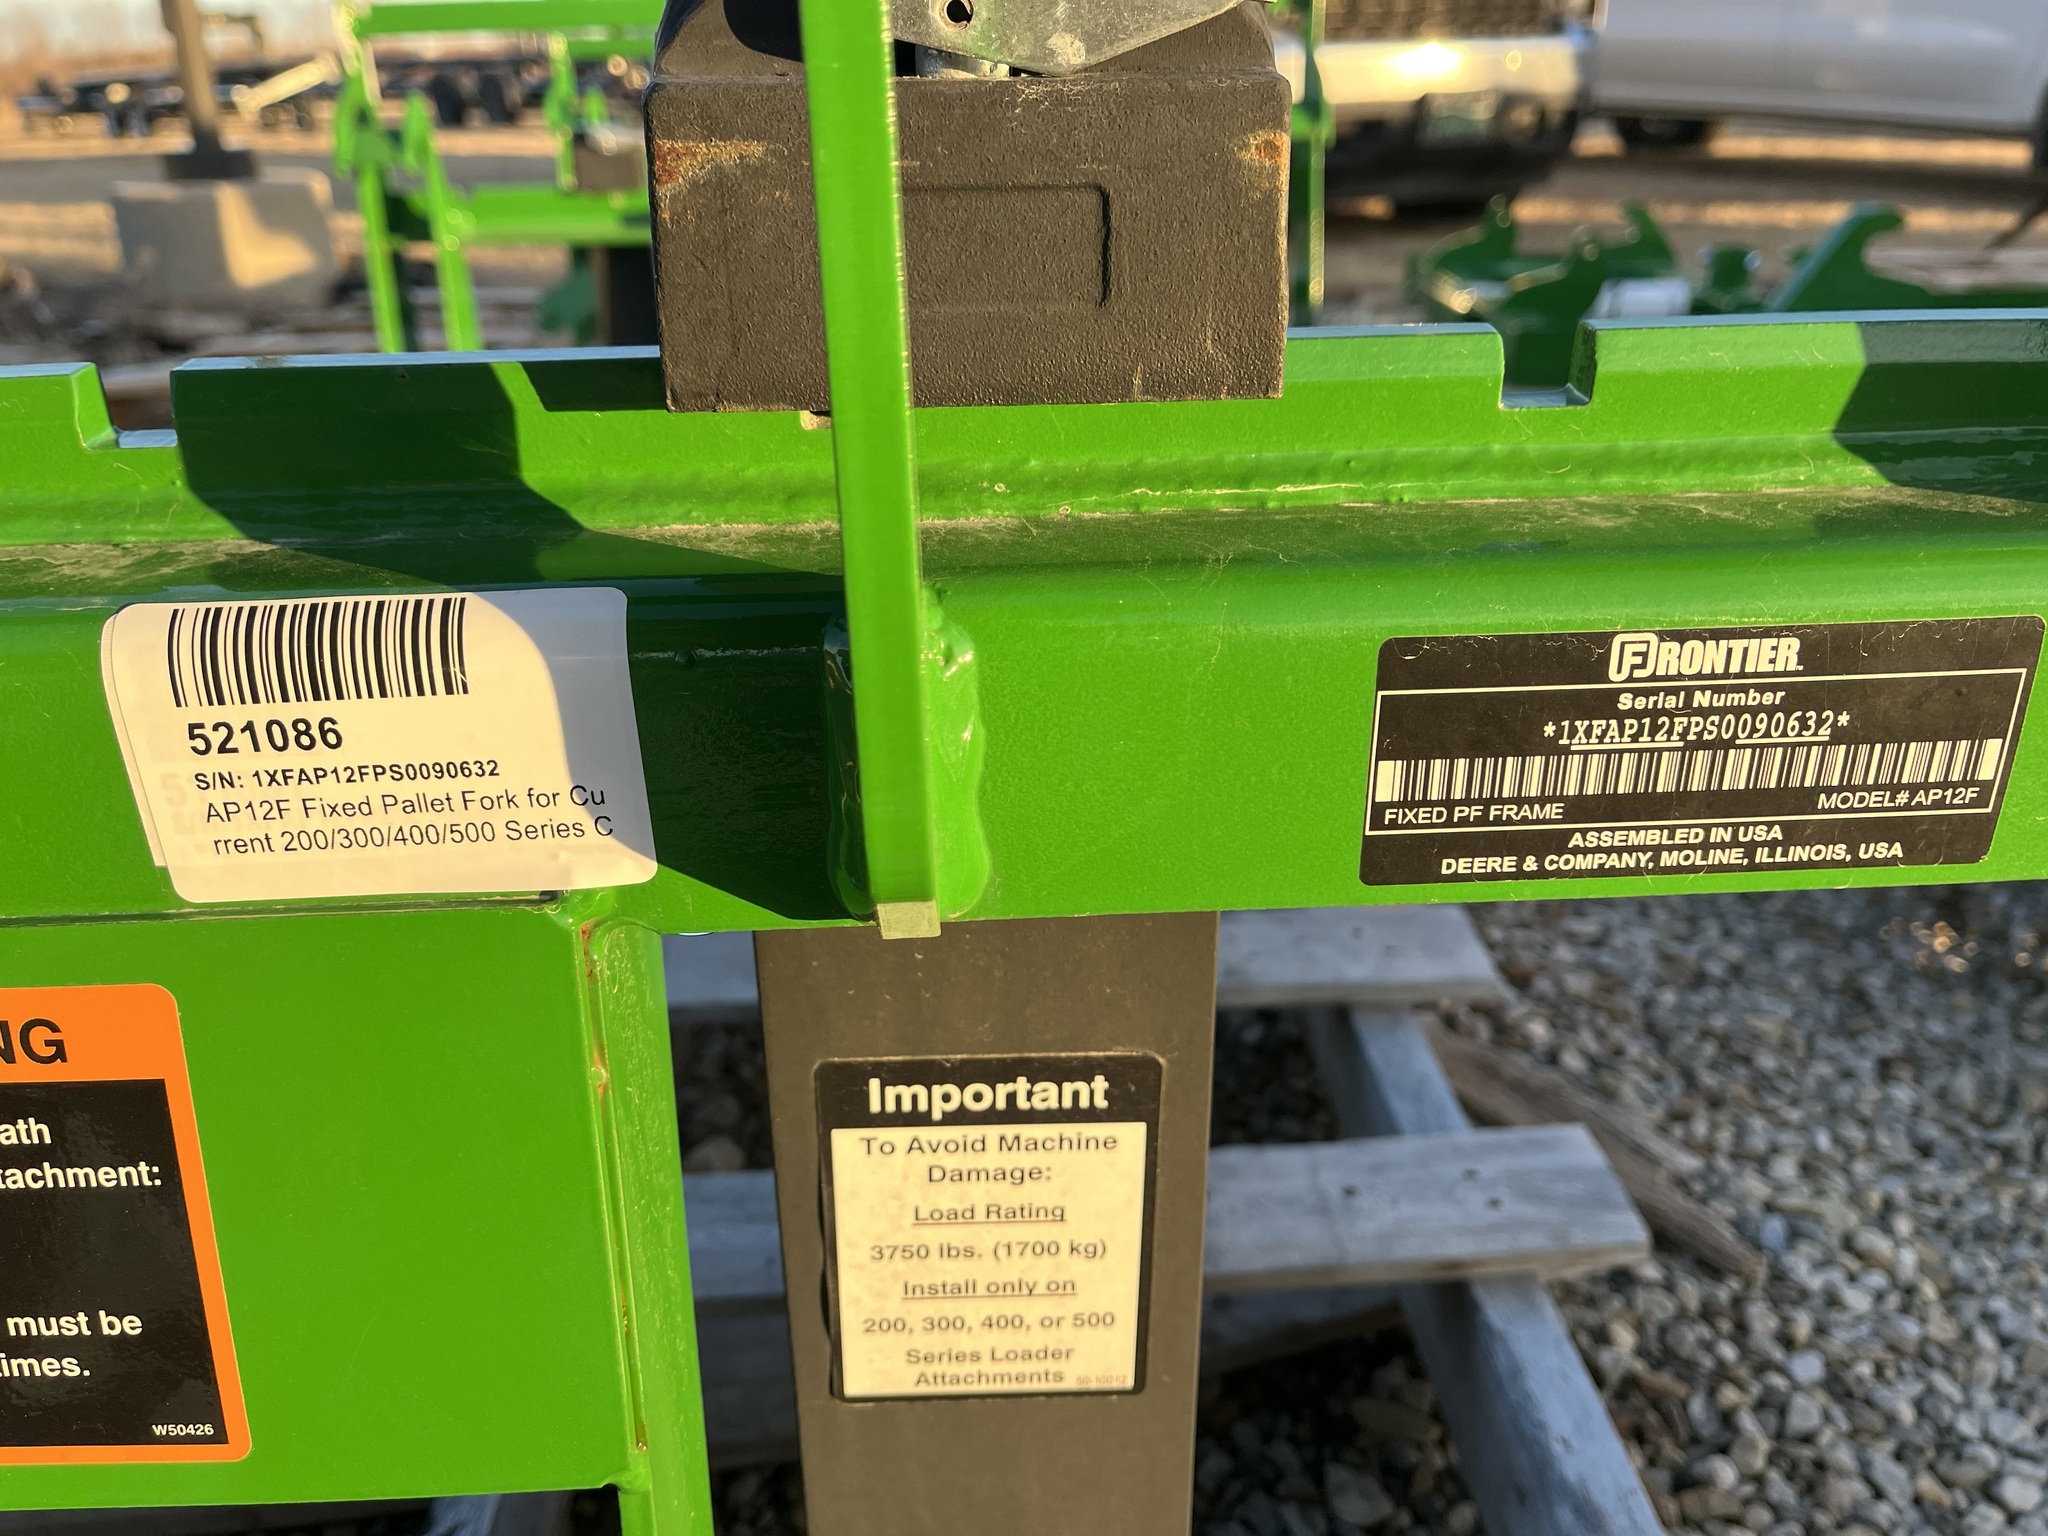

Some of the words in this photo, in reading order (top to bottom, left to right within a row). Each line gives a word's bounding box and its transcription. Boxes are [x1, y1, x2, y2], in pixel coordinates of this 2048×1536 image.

[1616, 691, 1686, 711] Serial
[1692, 688, 1786, 708] Number
[187, 716, 343, 756] 521086
[194, 770, 245, 791] S/N:
[252, 759, 500, 787] 1XFAP12FPS0090632
[206, 799, 291, 823] AP12F
[302, 795, 373, 819] Fixed
[381, 793, 455, 815] Pallet
[461, 788, 520, 812] Fork
[526, 786, 560, 809] for
[569, 784, 606, 807] Cu
[1817, 790, 1909, 810] MODEL#
[1911, 787, 1980, 806] AP12F
[1384, 806, 1448, 825] FIXED
[1453, 805, 1484, 823] PF
[1488, 802, 1565, 822] FRAME
[213, 832, 275, 856] rrent
[280, 821, 495, 852] 200/300/400/500
[505, 818, 586, 841] Series
[593, 816, 615, 838] C
[1567, 828, 1704, 849] ASSEMBLED
[1709, 827, 1732, 844] IN
[1737, 824, 1784, 843] USA
[1440, 855, 1517, 875] DEERE
[1522, 855, 1538, 872] &
[1543, 851, 1655, 874] COMPANY,
[1659, 848, 1749, 870] MOLINE,
[1754, 844, 1852, 864] ILLINOIS,
[1857, 841, 1904, 860] USA
[868, 1074, 1109, 1121] Important
[860, 1137, 896, 1156] To
[907, 1134, 987, 1155] Avoid
[998, 1132, 1119, 1153] Machine
[927, 1164, 1053, 1186] Damage:
[913, 1204, 976, 1224] Load
[985, 1202, 1067, 1223] Rating
[869, 1243, 930, 1261] 3750
[938, 1242, 983, 1260] lbs.
[993, 1240, 1061, 1262] (1700
[1069, 1238, 1108, 1260] kg)
[902, 1279, 978, 1300] Install
[985, 1278, 1039, 1297] only
[1046, 1278, 1078, 1296] on
[6, 1311, 92, 1336] must
[98, 1309, 143, 1335] be
[862, 1318, 915, 1336] 200,
[921, 1315, 974, 1335] 300,
[979, 1314, 1033, 1333] 400,
[1039, 1316, 1065, 1329] or
[1071, 1312, 1116, 1328] 500
[0, 1352, 92, 1377] imes.
[905, 1348, 982, 1365] Series
[990, 1346, 1075, 1363] Loader
[914, 1369, 1065, 1388] Attachments
[151, 1423, 215, 1436] W50426
